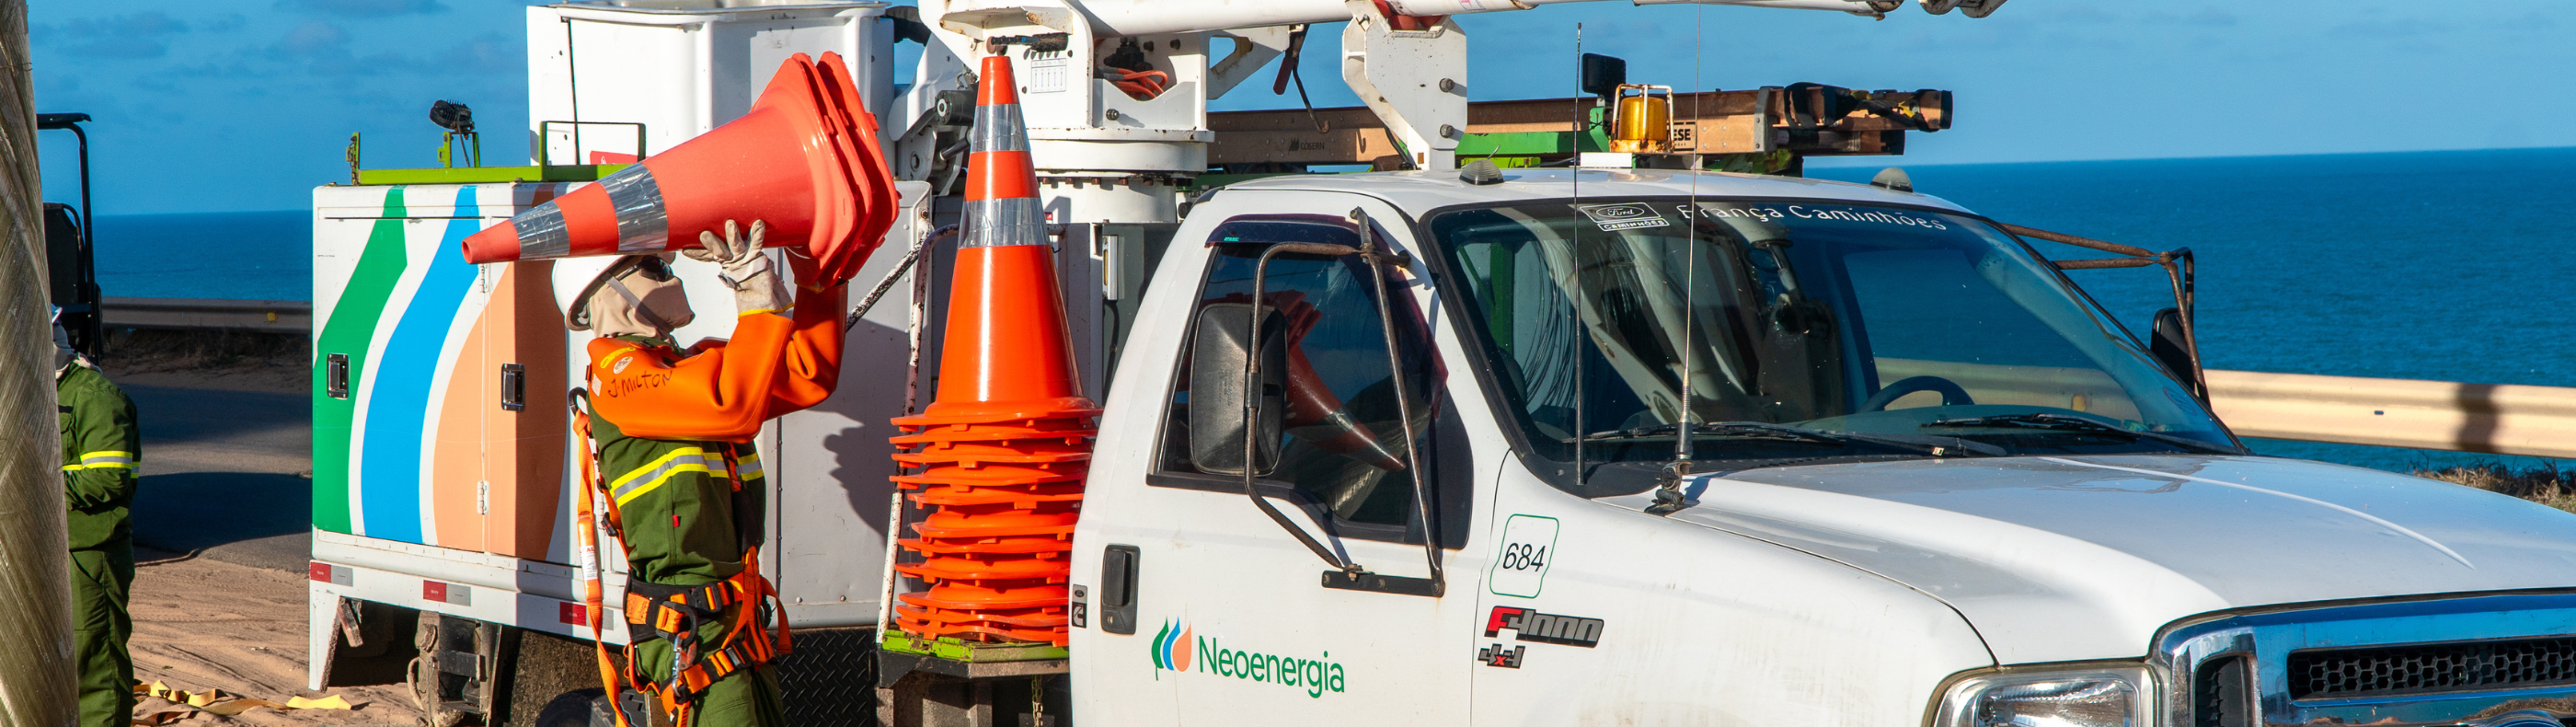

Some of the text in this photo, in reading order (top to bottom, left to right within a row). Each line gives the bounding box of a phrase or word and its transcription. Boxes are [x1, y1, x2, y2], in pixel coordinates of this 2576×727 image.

[1673, 128, 1691, 141] ESE
[1300, 142, 1325, 151] COSERN
[1606, 208, 1635, 216] Ford
[1676, 204, 1947, 230] França Caminhões
[1604, 219, 1665, 230] CAMINHÕES
[1502, 542, 1546, 572] 684
[1484, 606, 1604, 649] F4000
[1199, 635, 1345, 698] Neoenergia
